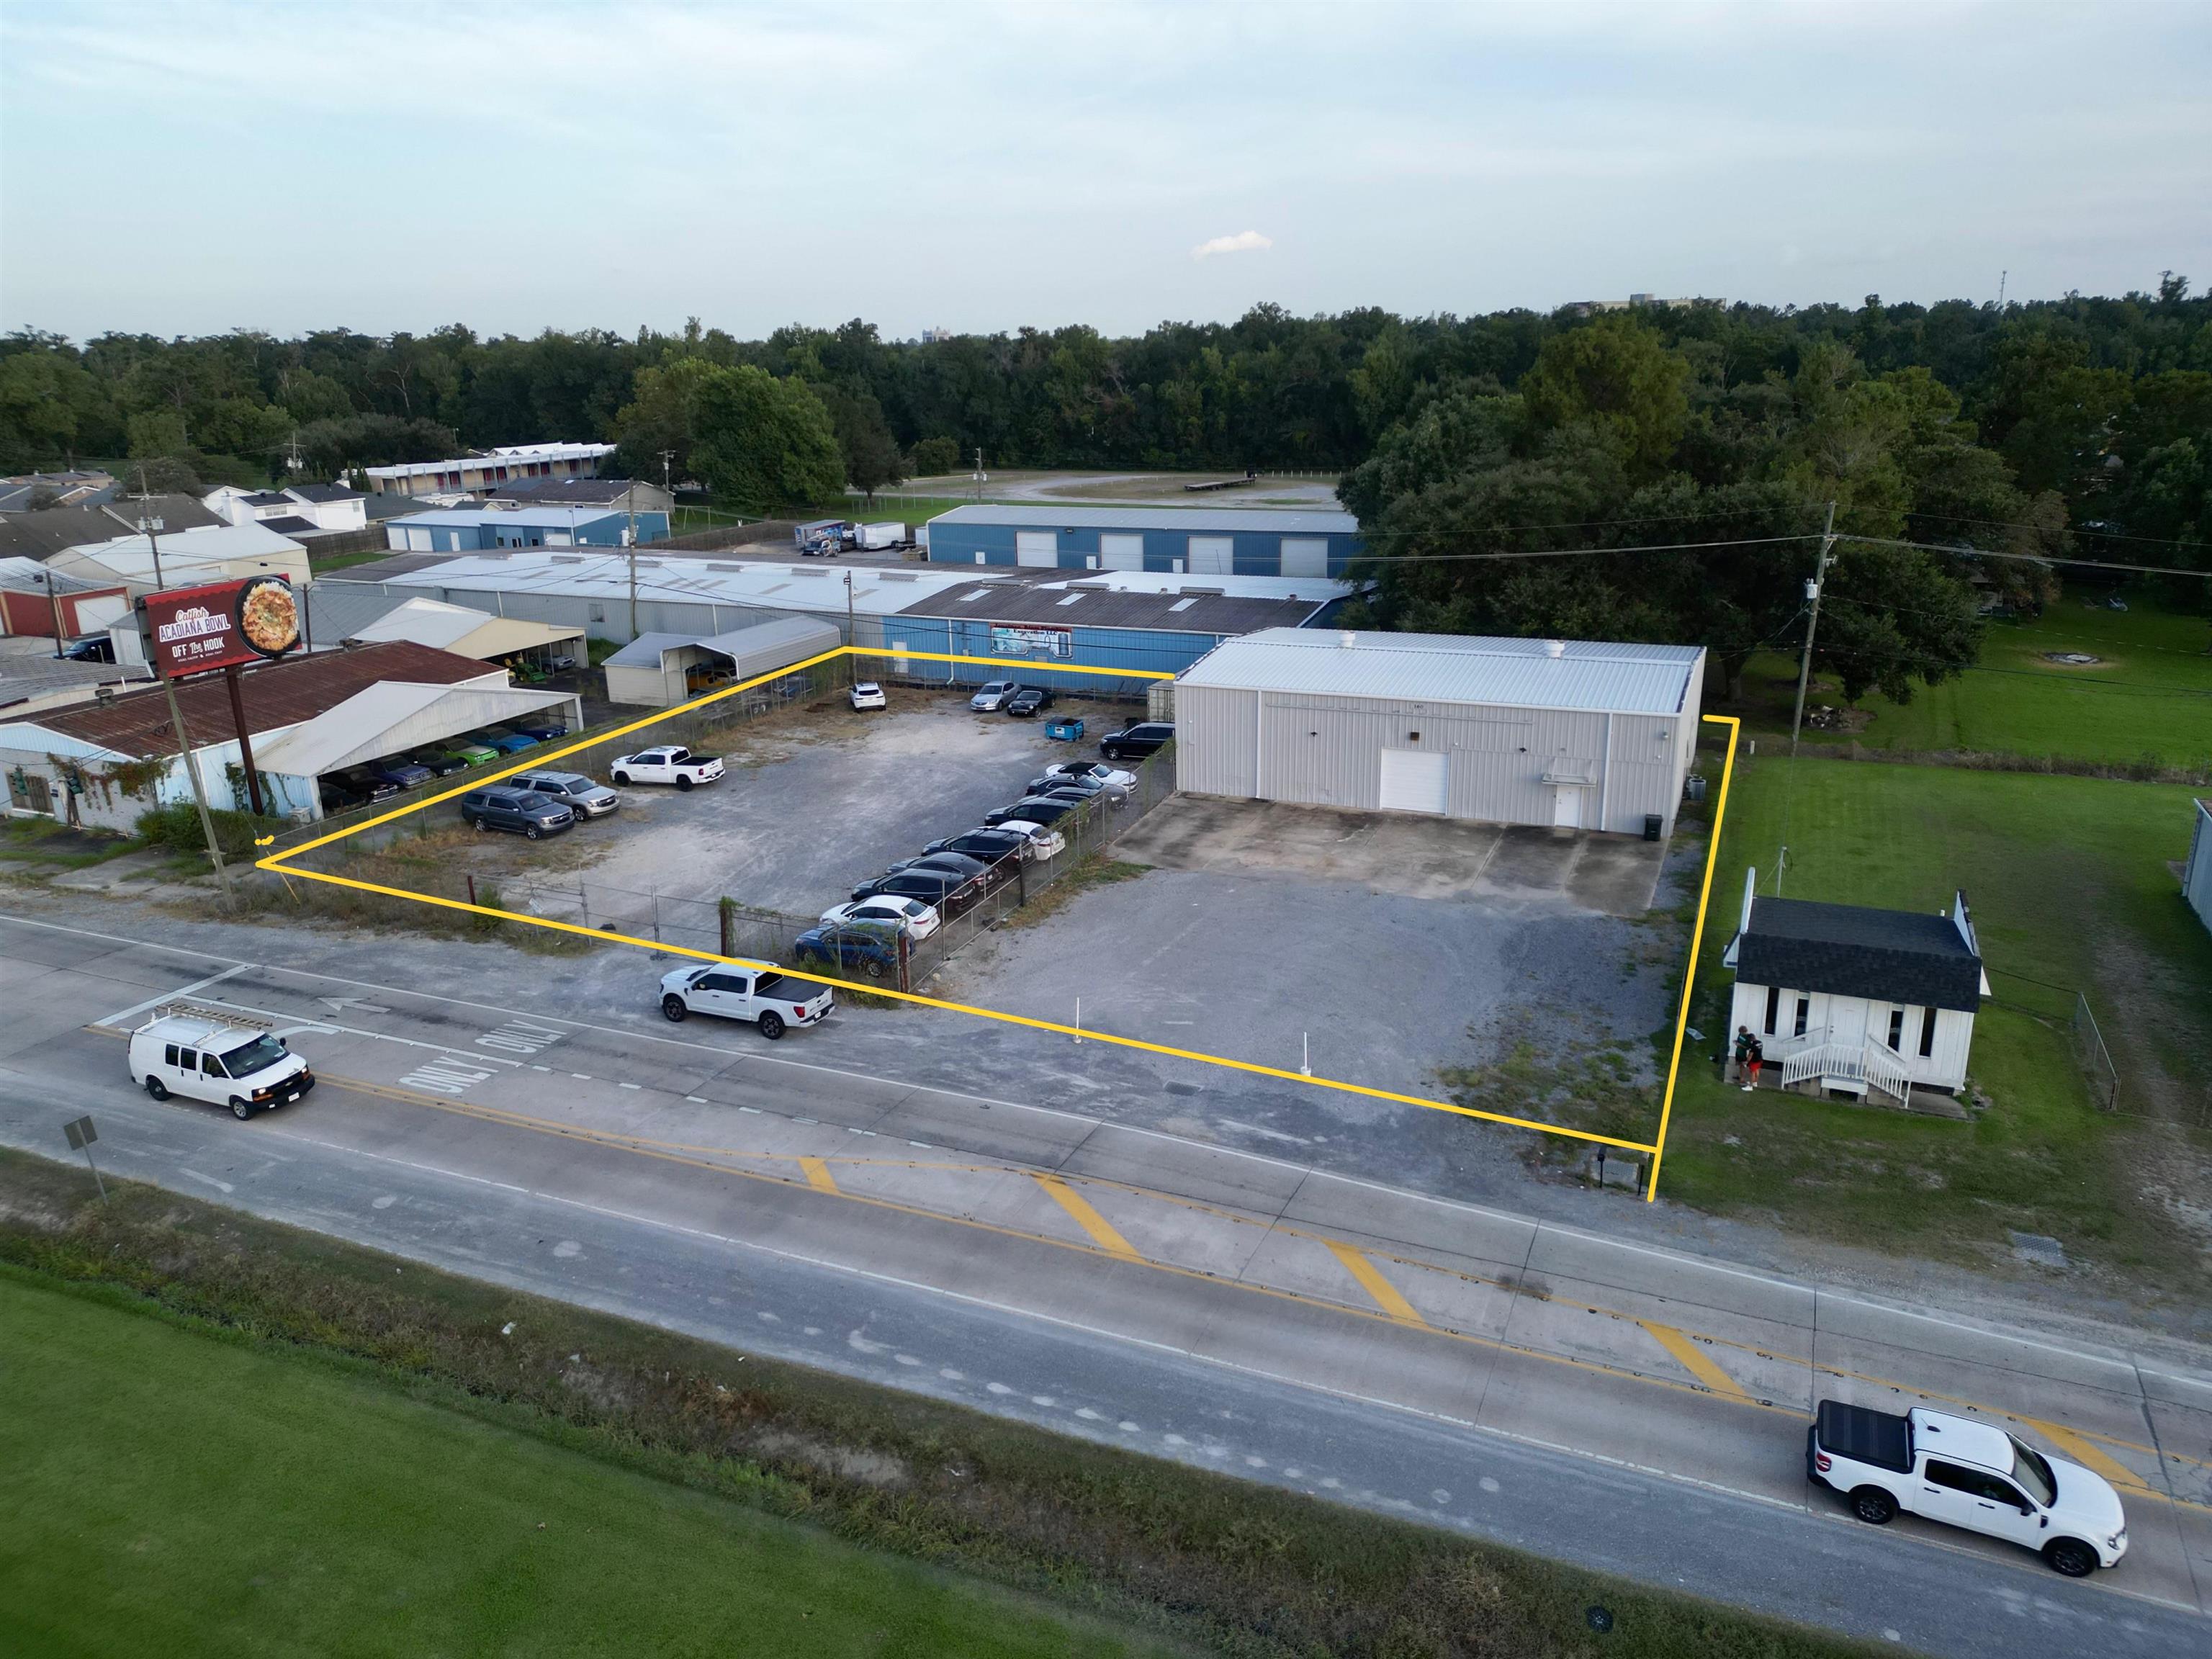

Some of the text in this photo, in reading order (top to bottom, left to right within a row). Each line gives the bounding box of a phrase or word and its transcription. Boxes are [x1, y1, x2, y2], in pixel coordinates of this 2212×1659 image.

[160, 614, 230, 642] ACADIANA BOWL
[176, 607, 209, 622] Catfish
[172, 644, 187, 657] OFF
[189, 642, 203, 654] The
[203, 637, 225, 651] HOOK
[475, 1020, 567, 1053] ONLY
[398, 1056, 499, 1093] ONLY
